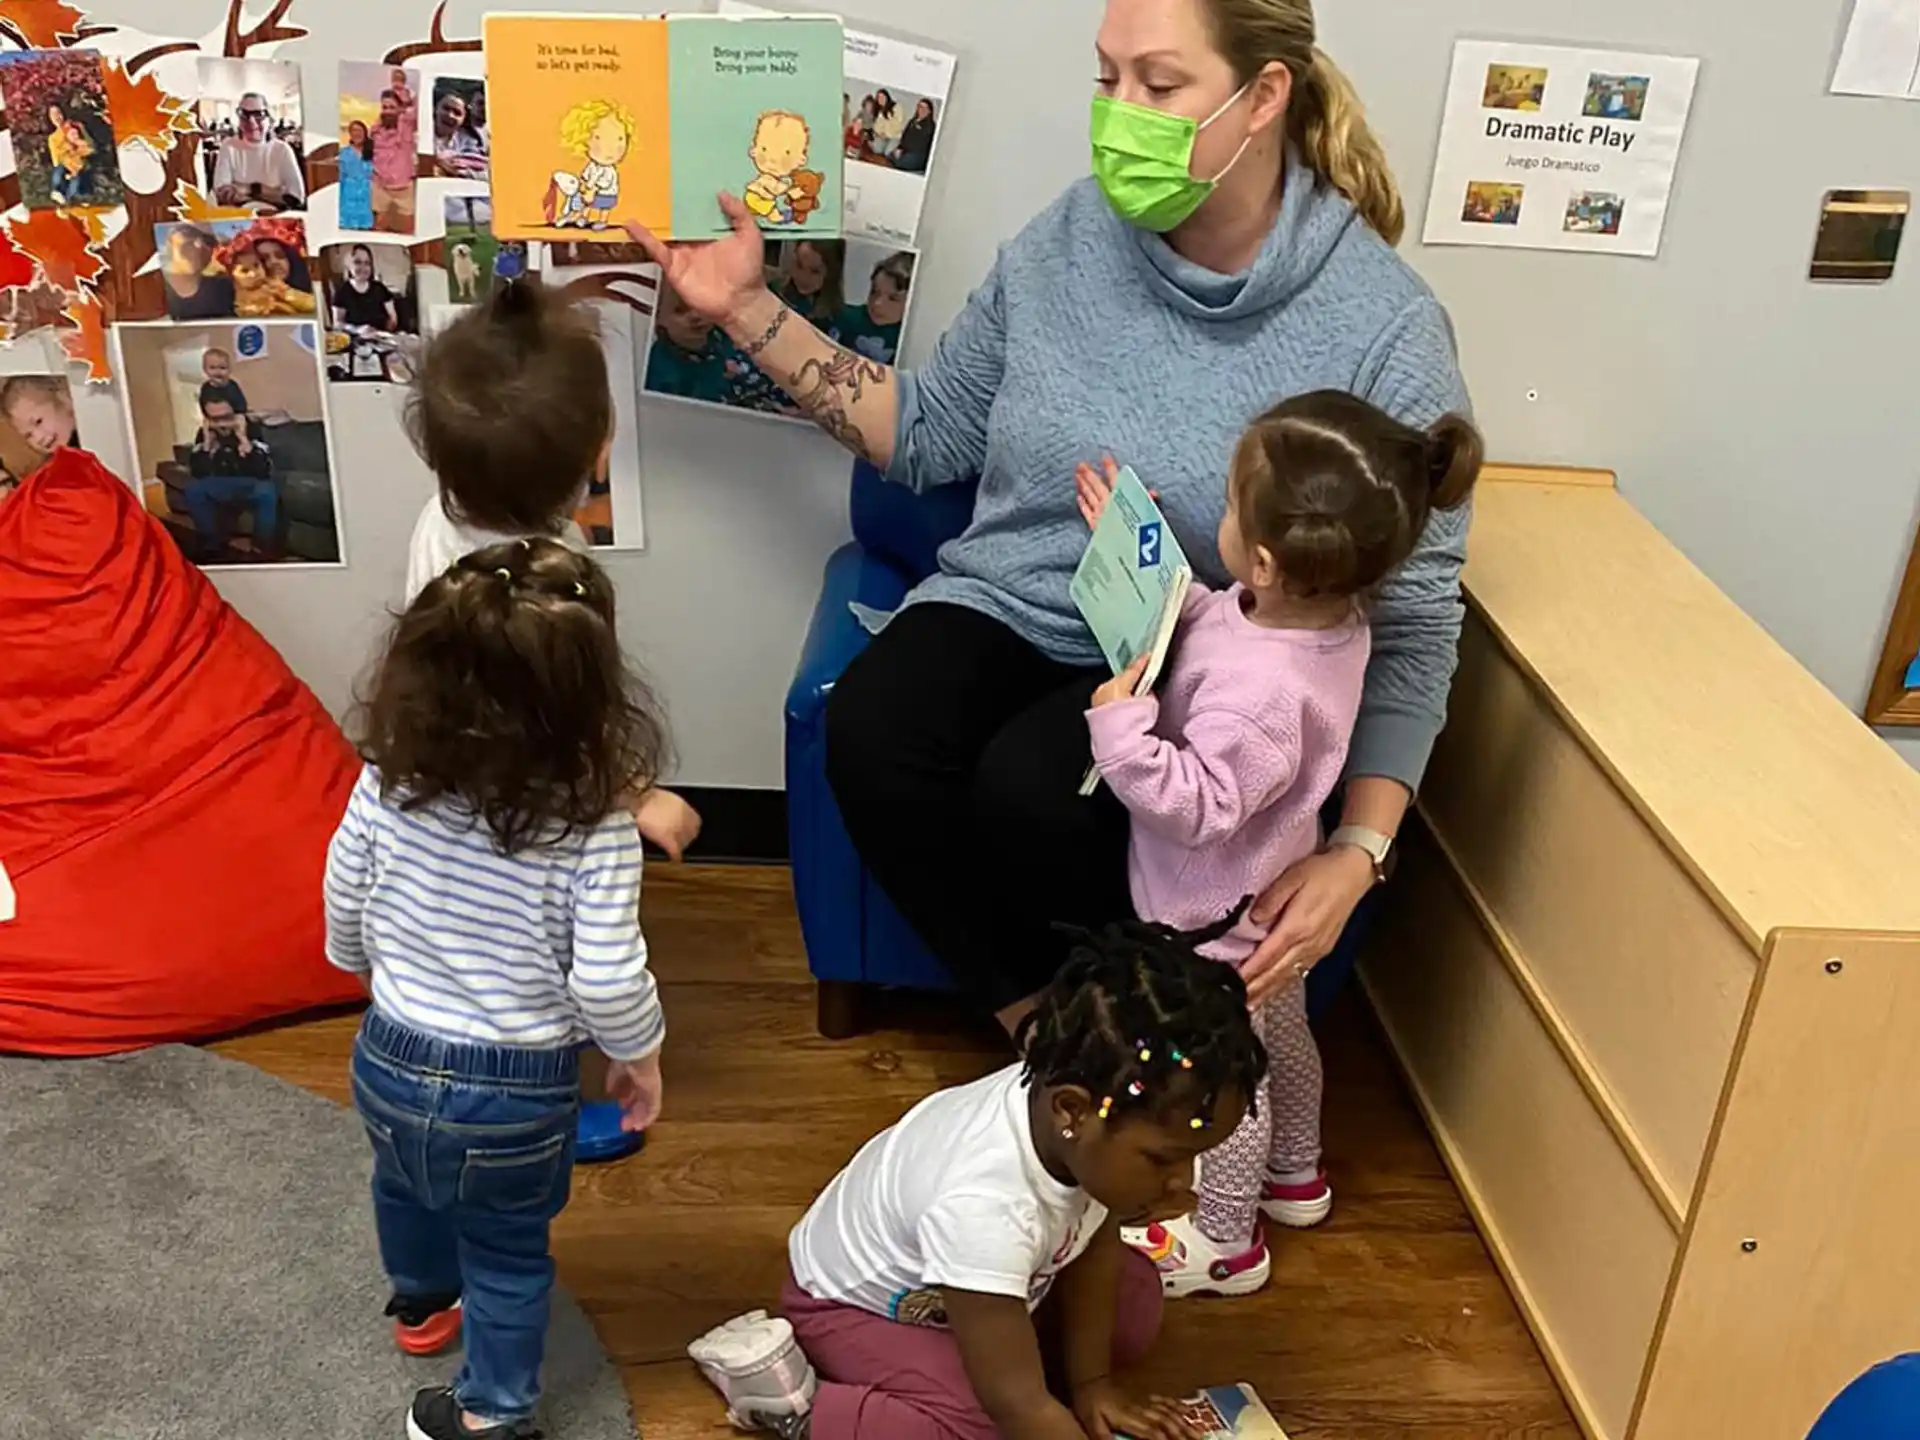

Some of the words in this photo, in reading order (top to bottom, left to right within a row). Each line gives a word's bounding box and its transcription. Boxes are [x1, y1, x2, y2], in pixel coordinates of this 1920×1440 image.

[554, 45, 578, 56] time
[581, 43, 596, 56] for
[713, 45, 741, 60] Bring
[743, 49, 766, 61] your
[573, 60, 590, 73] get
[715, 61, 742, 76] Bring
[745, 65, 767, 75] your
[1485, 116, 1584, 144] Dramatic
[1588, 125, 1636, 153] Play
[1505, 153, 1540, 170] Juego
